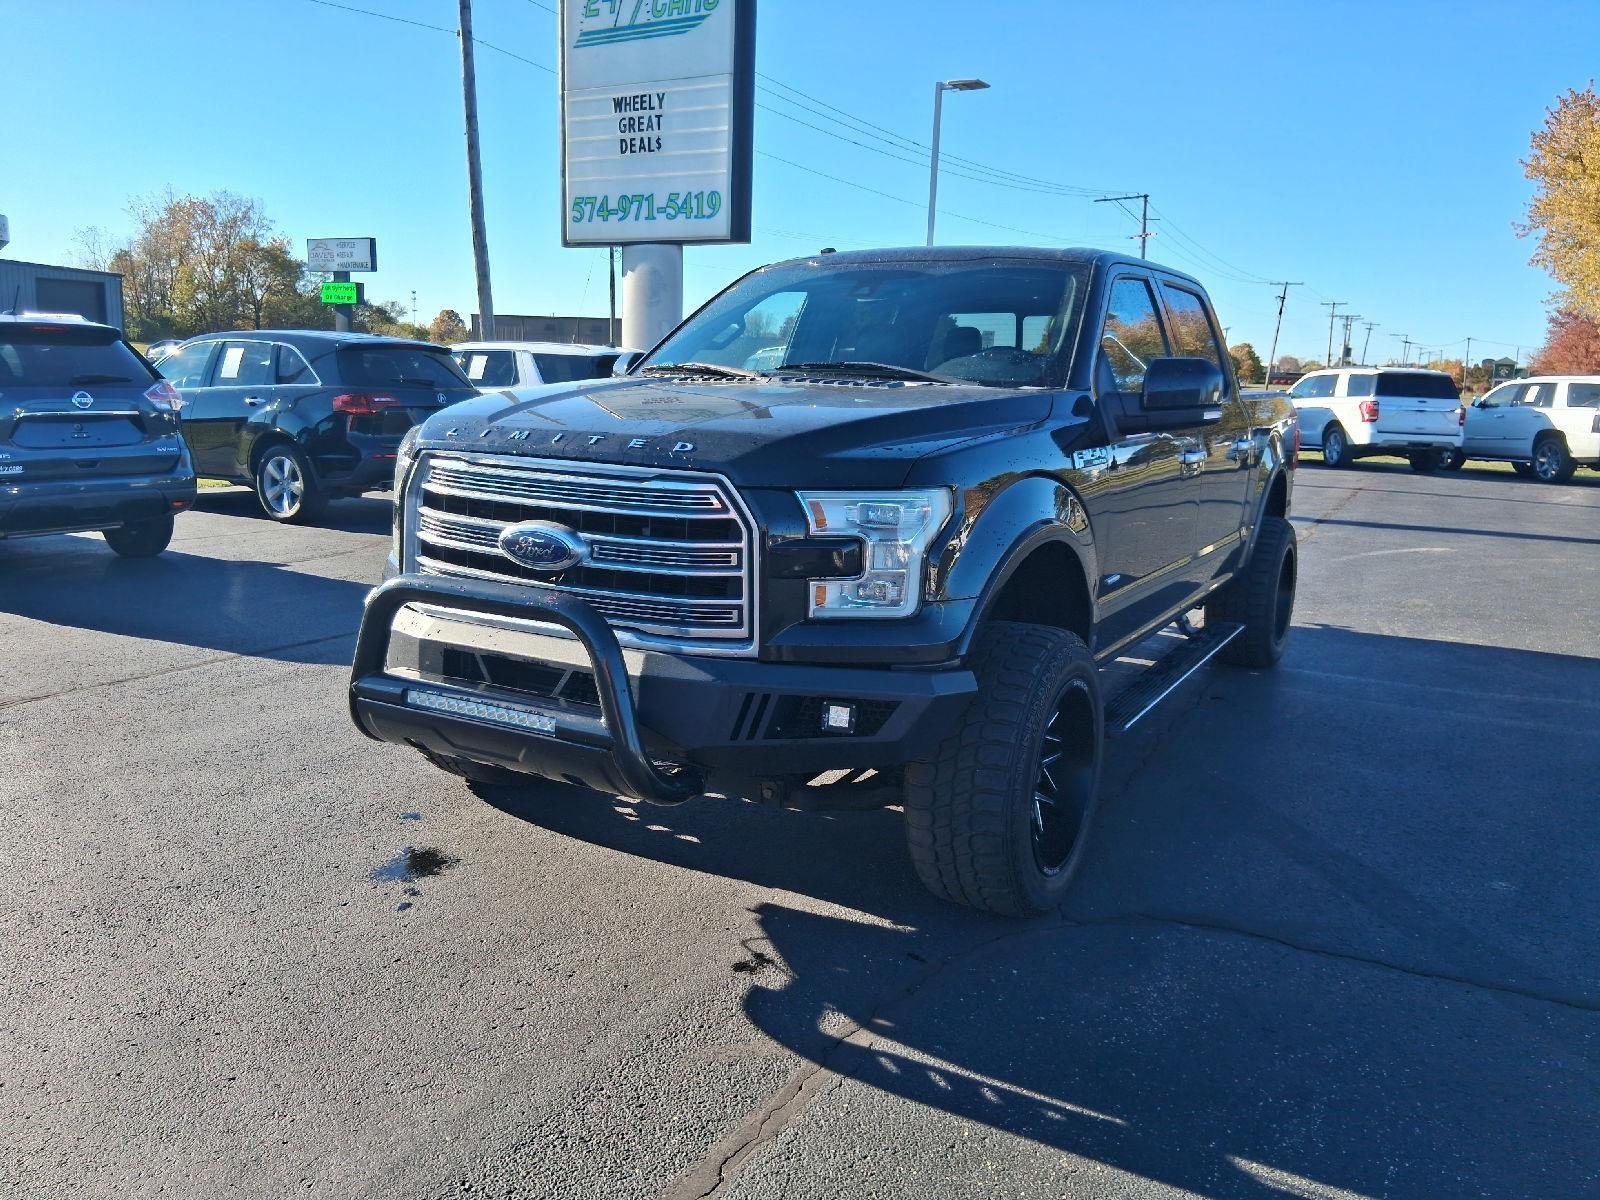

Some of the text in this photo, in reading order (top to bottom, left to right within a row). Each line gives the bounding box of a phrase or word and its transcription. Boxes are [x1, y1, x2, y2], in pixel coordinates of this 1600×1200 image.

[612, 92, 666, 114] WHEELY
[618, 114, 663, 134] GREAT
[619, 136, 662, 155] DEAL$
[571, 190, 722, 223] 574-971-5419
[340, 261, 369, 269] MAINTENANCE
[446, 427, 694, 452] LIMITED
[511, 535, 555, 559] Ford
